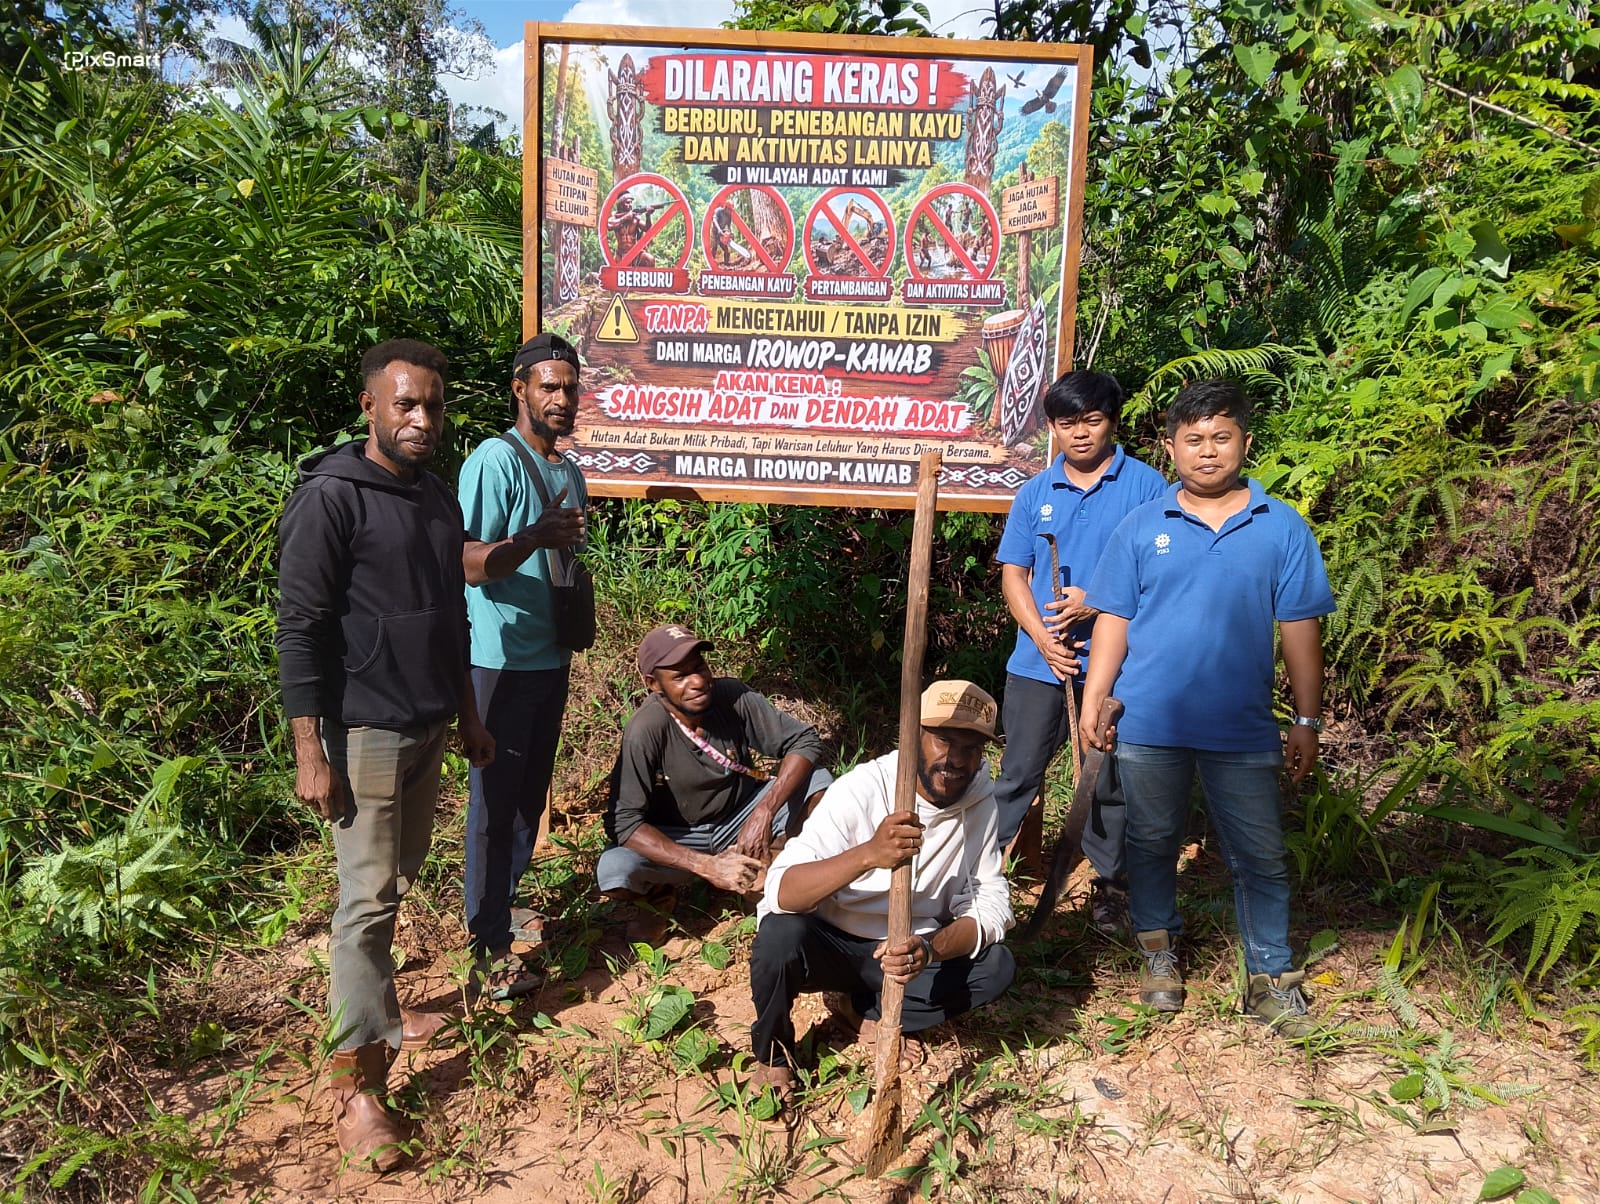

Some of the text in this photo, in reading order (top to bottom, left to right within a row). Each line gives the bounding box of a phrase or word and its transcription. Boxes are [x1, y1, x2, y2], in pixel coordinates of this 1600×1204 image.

[665, 59, 938, 105] DILARANG KERAS !
[664, 107, 962, 138] BERBURU, PENEBANGAN KAYU
[684, 136, 931, 166] DAN AKTIVITAS LAINYA
[553, 168, 593, 188] HUTAN ADAT
[727, 167, 887, 185] DI WILAYAH ADAT KAMI
[558, 184, 587, 201] TITIPAN
[1008, 184, 1049, 203] JAGA HUTAN
[555, 200, 589, 216] LELUHUR
[1018, 200, 1037, 213] JAGA
[1008, 210, 1047, 227] KEHIDUPAN
[617, 271, 674, 288] BERBURU
[701, 275, 793, 293] PENEBANGAN KAYU
[811, 280, 887, 297] PERTAMBANGAN
[907, 284, 1001, 299] DAN AKTIVITAS LAINYA
[645, 305, 941, 337] TANPA MENGETAHUI / TANPA IZIN
[656, 338, 932, 375] DARI MARGA IROWOP-KAWAB
[715, 373, 842, 396] AKAN KENA :
[608, 389, 966, 430] SANGSIH ADAT DAN DENDAH ADAT
[591, 430, 620, 443] Hutan
[623, 431, 647, 445] Adat
[649, 433, 680, 446] Bukan
[683, 434, 707, 447] Milik
[710, 435, 747, 450] Pribadi,
[752, 437, 772, 452] Tapi
[774, 438, 813, 452] Warisan
[816, 440, 853, 453] Leluhur
[856, 443, 878, 457] Yang
[881, 442, 910, 456] Harus
[947, 444, 991, 459] Bersama.
[675, 455, 912, 484] MARGA IROWOP-KAWAB
